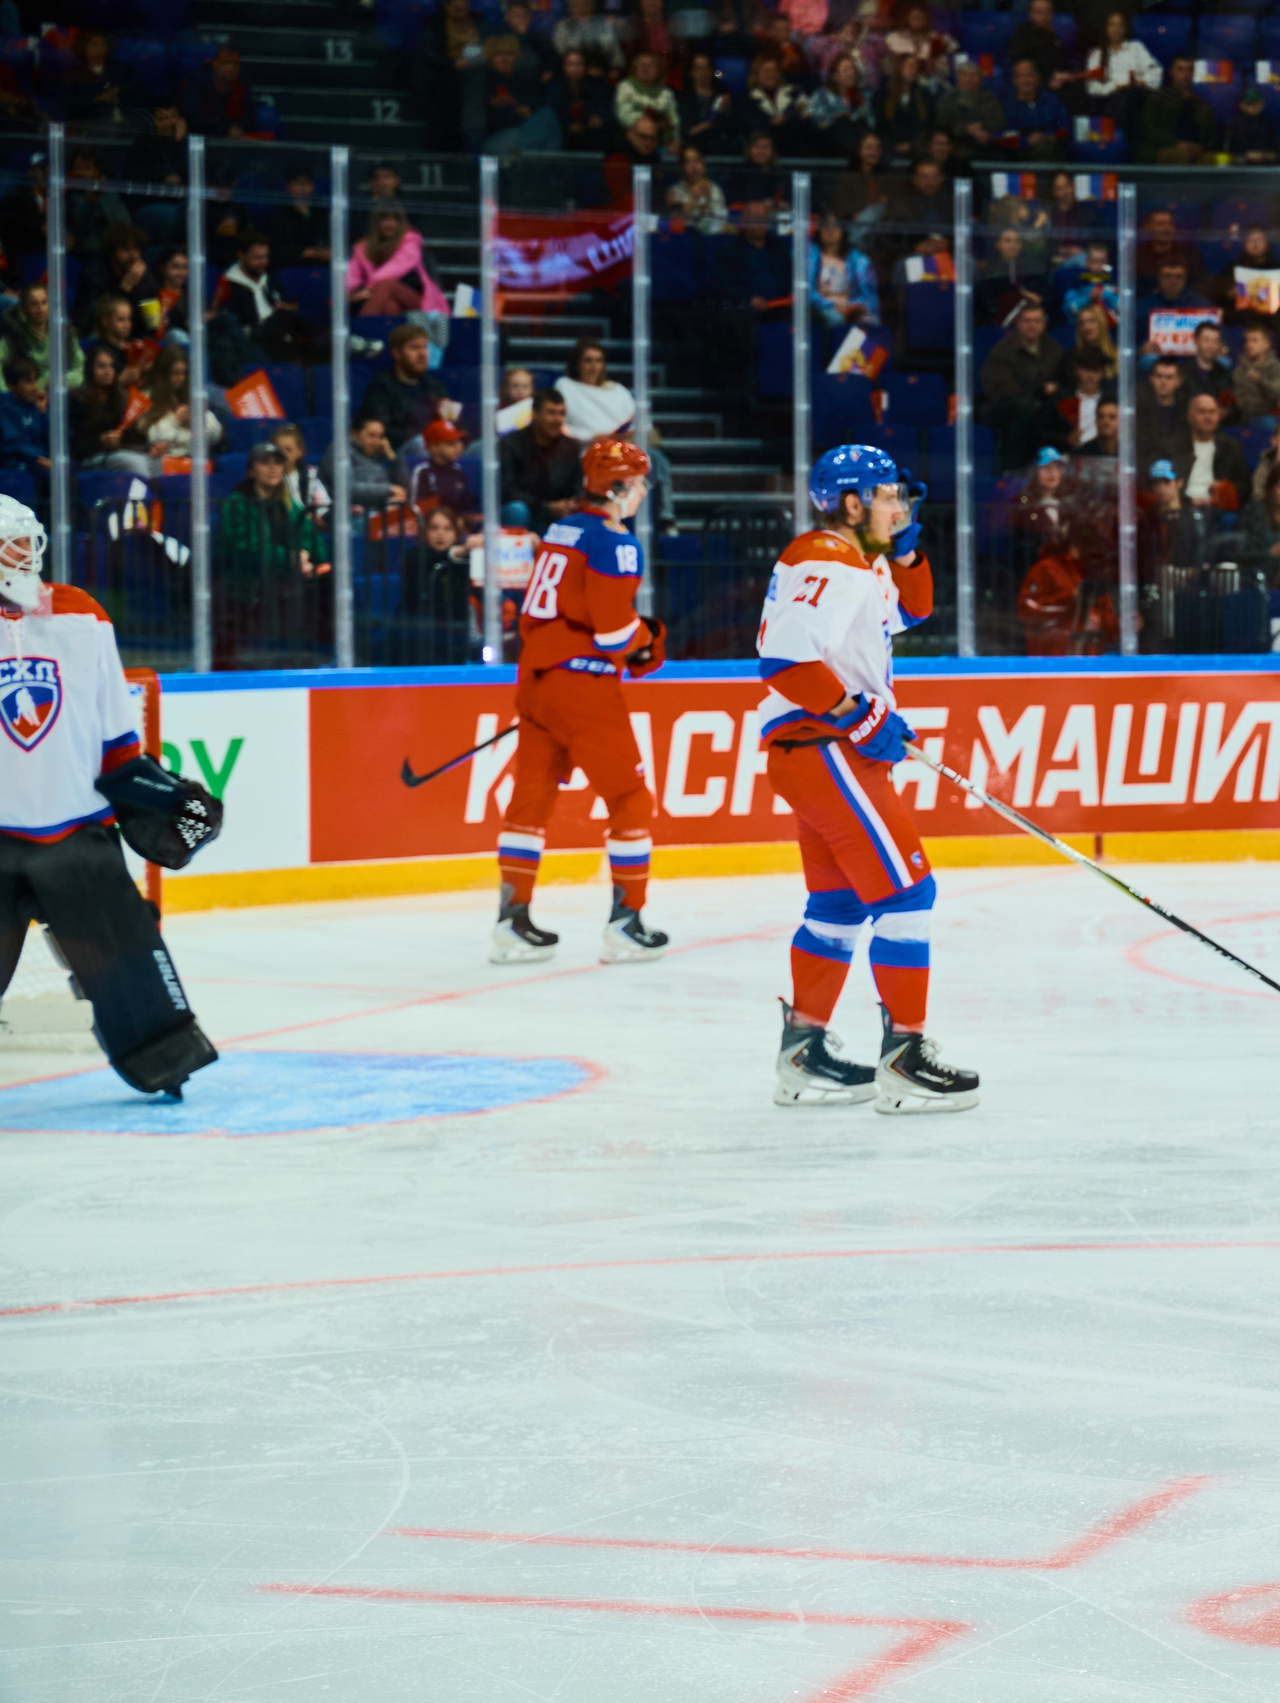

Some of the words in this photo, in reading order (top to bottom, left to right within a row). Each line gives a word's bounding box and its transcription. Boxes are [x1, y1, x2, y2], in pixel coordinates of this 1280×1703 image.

[324, 38, 353, 62] 13
[370, 99, 401, 123] 12
[615, 544, 638, 573] 18
[521, 550, 568, 619] 18
